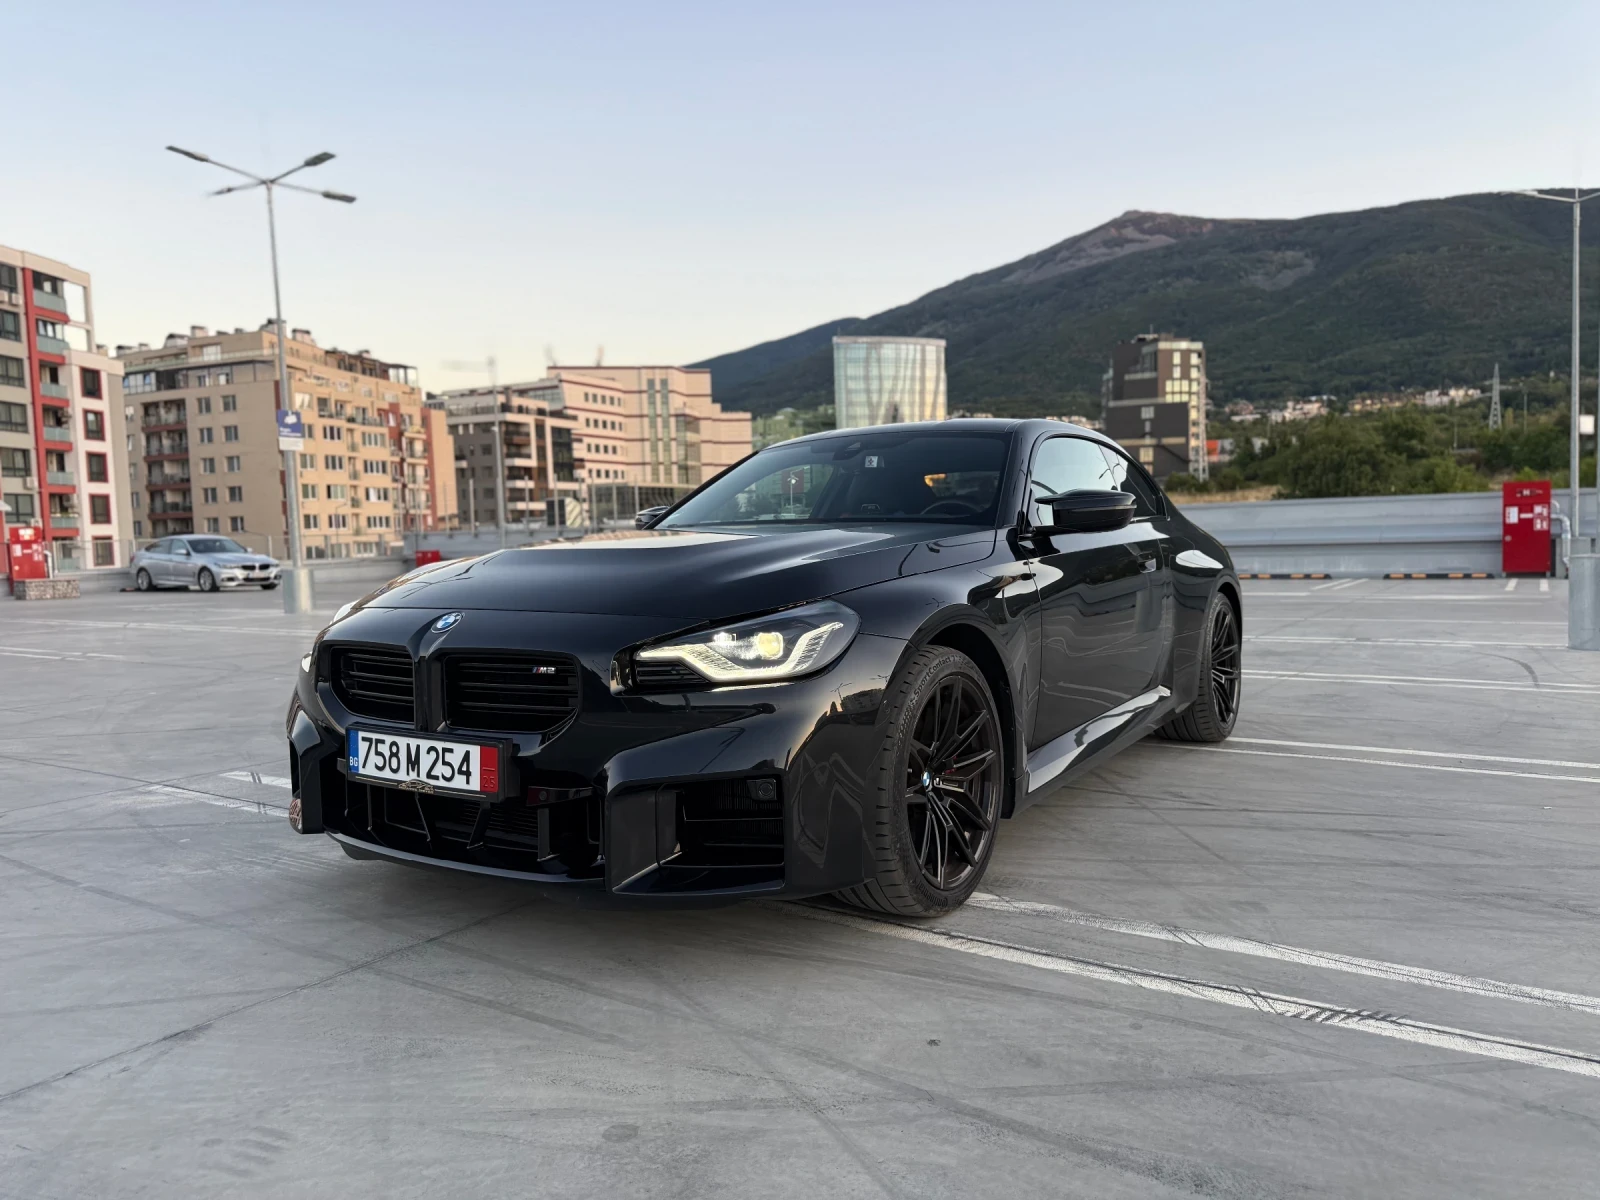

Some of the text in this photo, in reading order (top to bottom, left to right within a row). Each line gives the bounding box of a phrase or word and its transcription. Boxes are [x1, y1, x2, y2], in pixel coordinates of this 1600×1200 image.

[914, 656, 951, 697] SportContact
[350, 756, 359, 767] BG
[361, 736, 472, 785] 758 M 254
